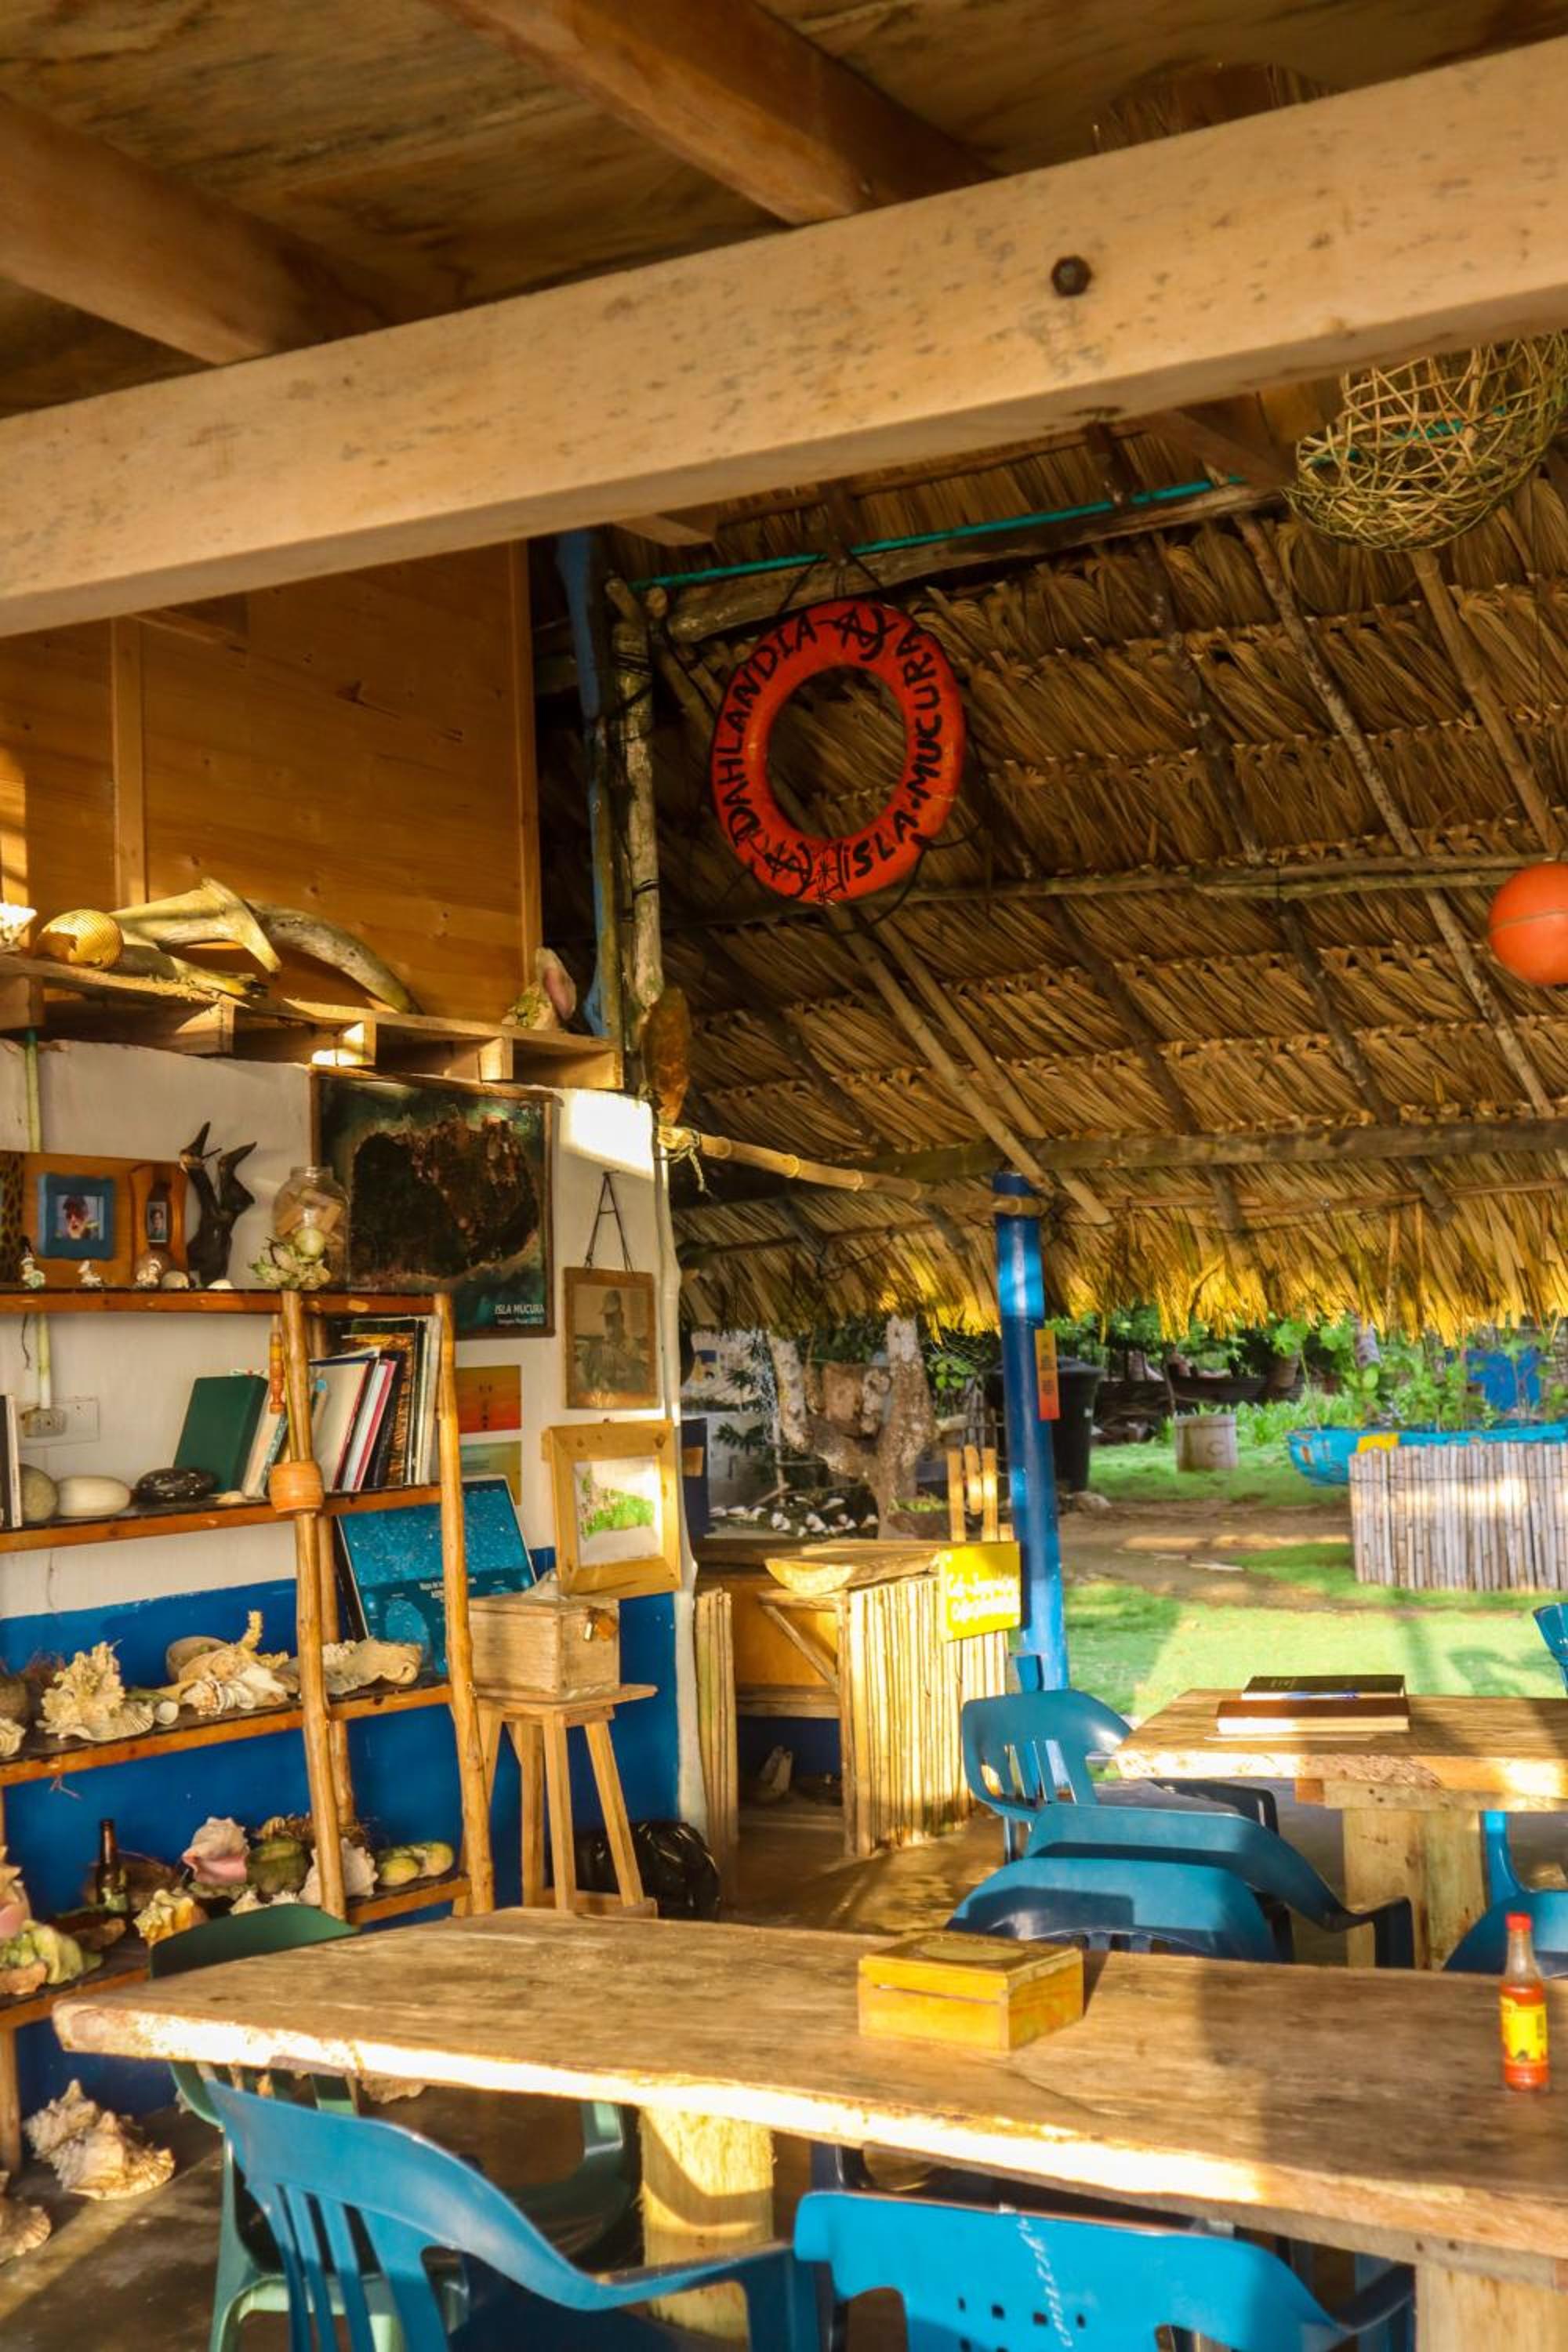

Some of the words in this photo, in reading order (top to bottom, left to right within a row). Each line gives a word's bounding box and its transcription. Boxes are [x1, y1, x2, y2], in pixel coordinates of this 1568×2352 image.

[717, 613, 817, 848] DAHLANDIA
[495, 1304, 512, 1315] ISLA
[514, 1304, 545, 1315] MUCURA
